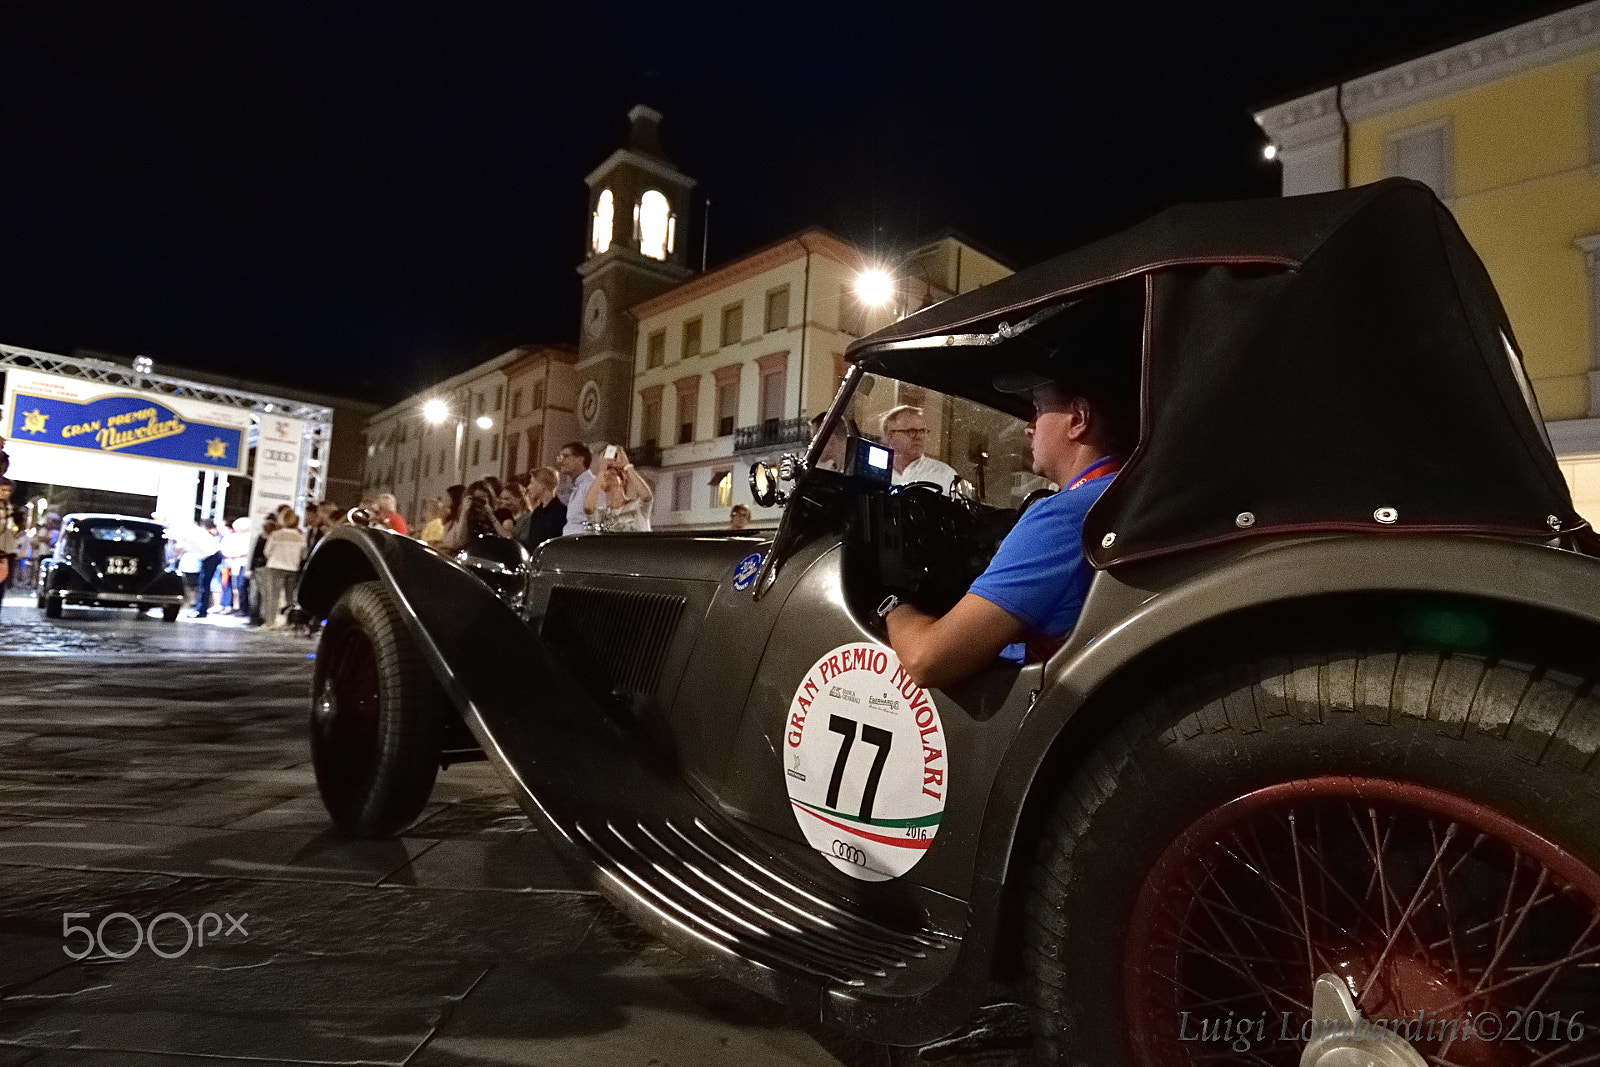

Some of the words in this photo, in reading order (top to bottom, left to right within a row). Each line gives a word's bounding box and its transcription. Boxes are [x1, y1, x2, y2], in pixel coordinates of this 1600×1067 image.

[62, 421, 100, 438] GRAN
[107, 408, 157, 427] PREMIO
[95, 414, 186, 450] Nuvolari
[788, 677, 819, 748] GRAN
[819, 648, 888, 684] PREMIO
[890, 663, 943, 801] NUVOLARI
[825, 714, 893, 824] 77
[906, 824, 927, 842] 2016
